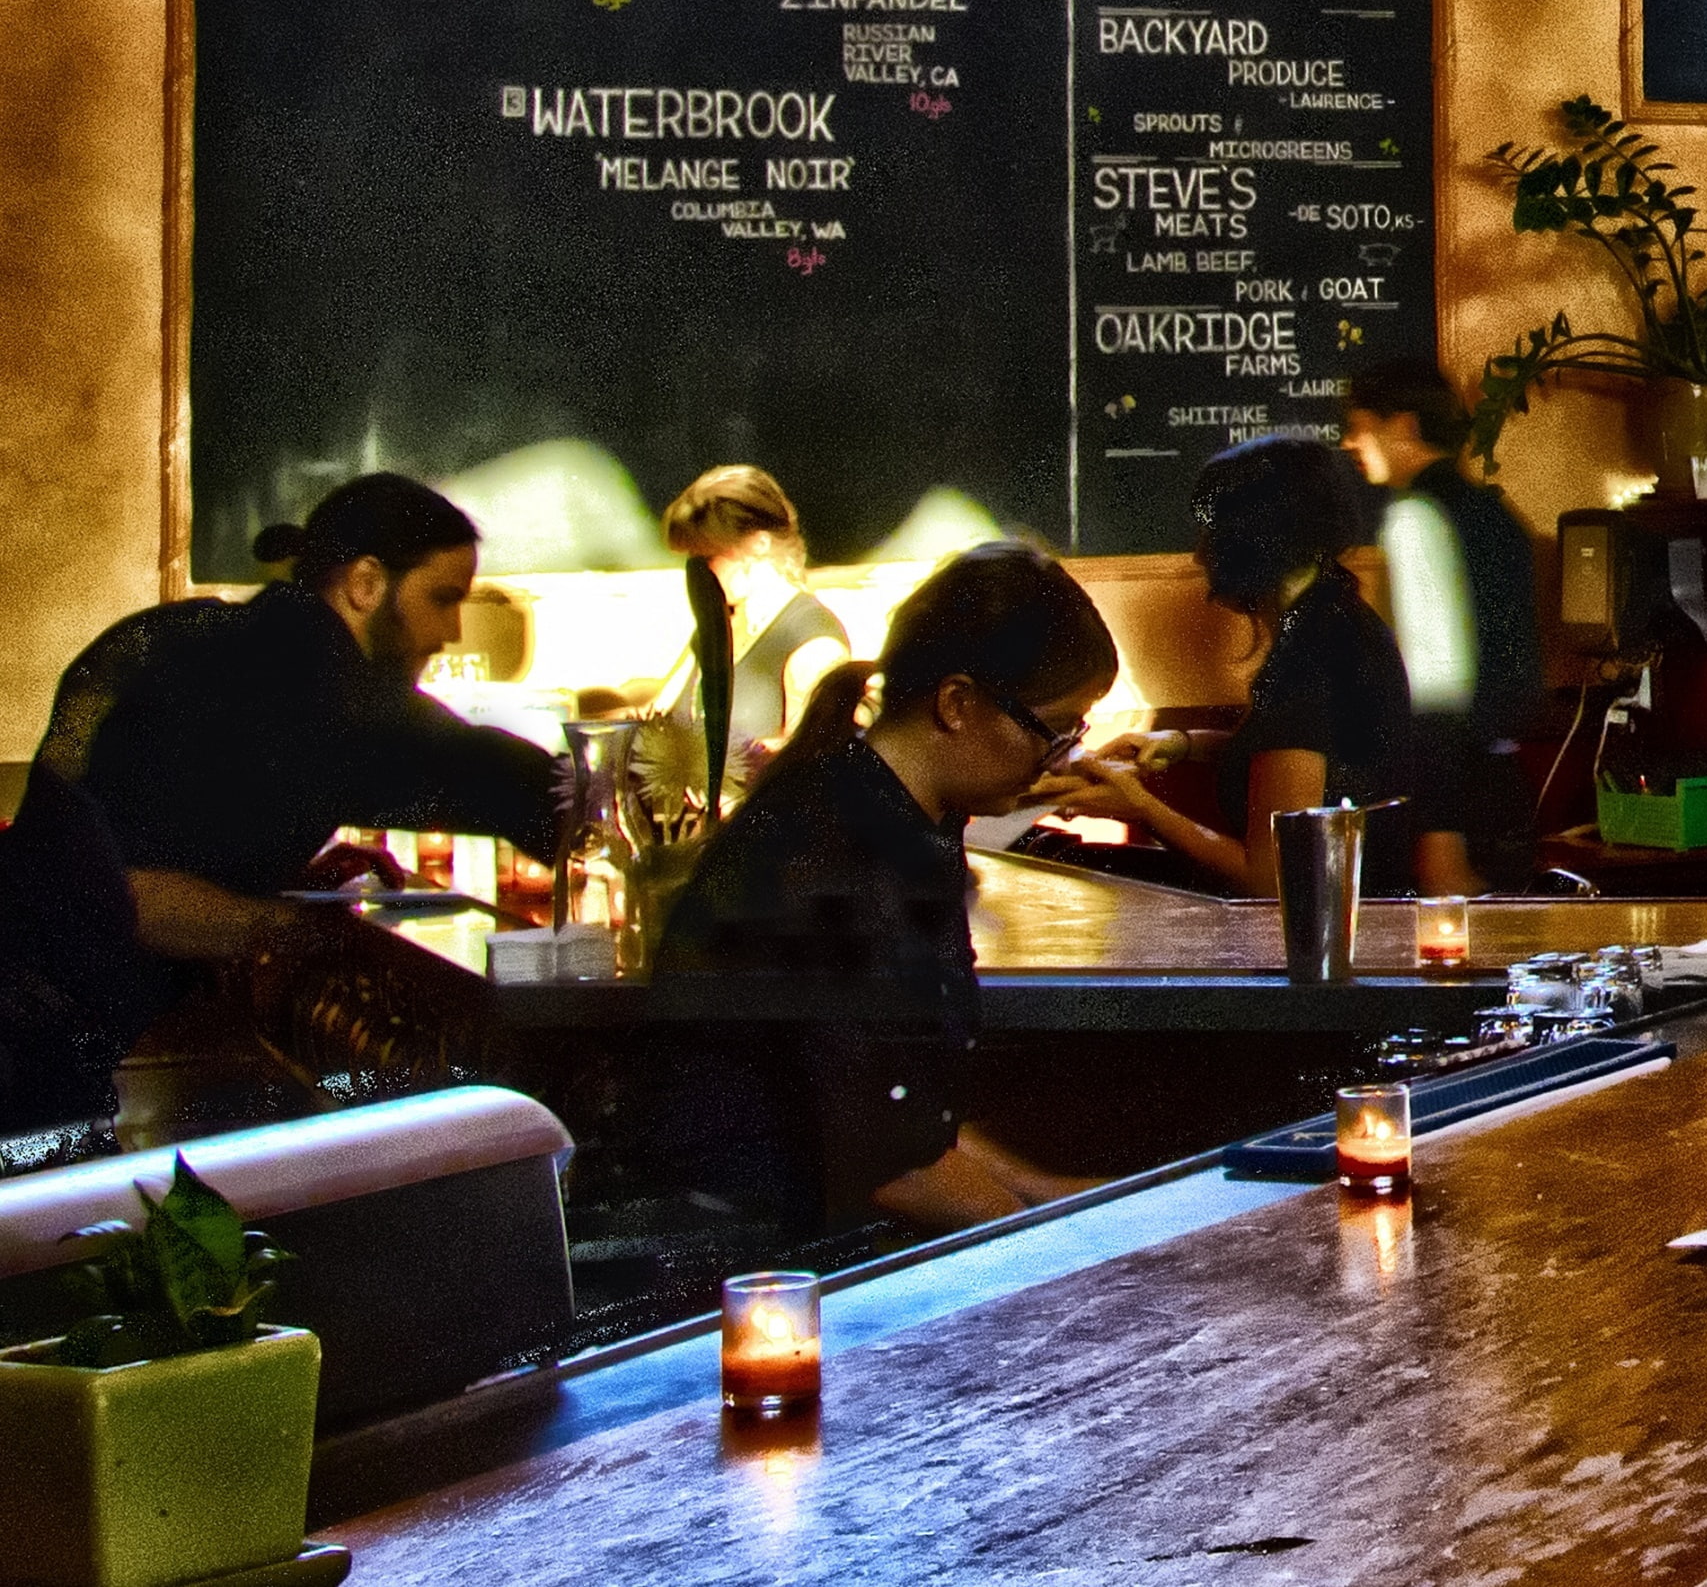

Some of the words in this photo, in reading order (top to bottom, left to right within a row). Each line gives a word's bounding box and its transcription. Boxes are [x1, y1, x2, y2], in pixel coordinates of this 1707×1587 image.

[843, 23, 936, 43] RUSSIAN
[1099, 18, 1270, 55] BACKYARD
[843, 43, 912, 63] RIVER
[1228, 60, 1345, 88] PRODUCE
[532, 87, 838, 142] WATERBROOK
[1134, 113, 1223, 134] SPROUTS
[1209, 141, 1353, 161] MICROGREENS
[671, 200, 776, 220] COLUMBIA
[811, 218, 847, 240] WA
[1155, 213, 1248, 239] MEATS
[1235, 279, 1293, 303] PORK
[1318, 277, 1386, 300] GOAT
[1095, 311, 1298, 354] OAKRIDGE
[1225, 354, 1302, 377] FARMS
[1167, 405, 1270, 427] SHIITAKE
